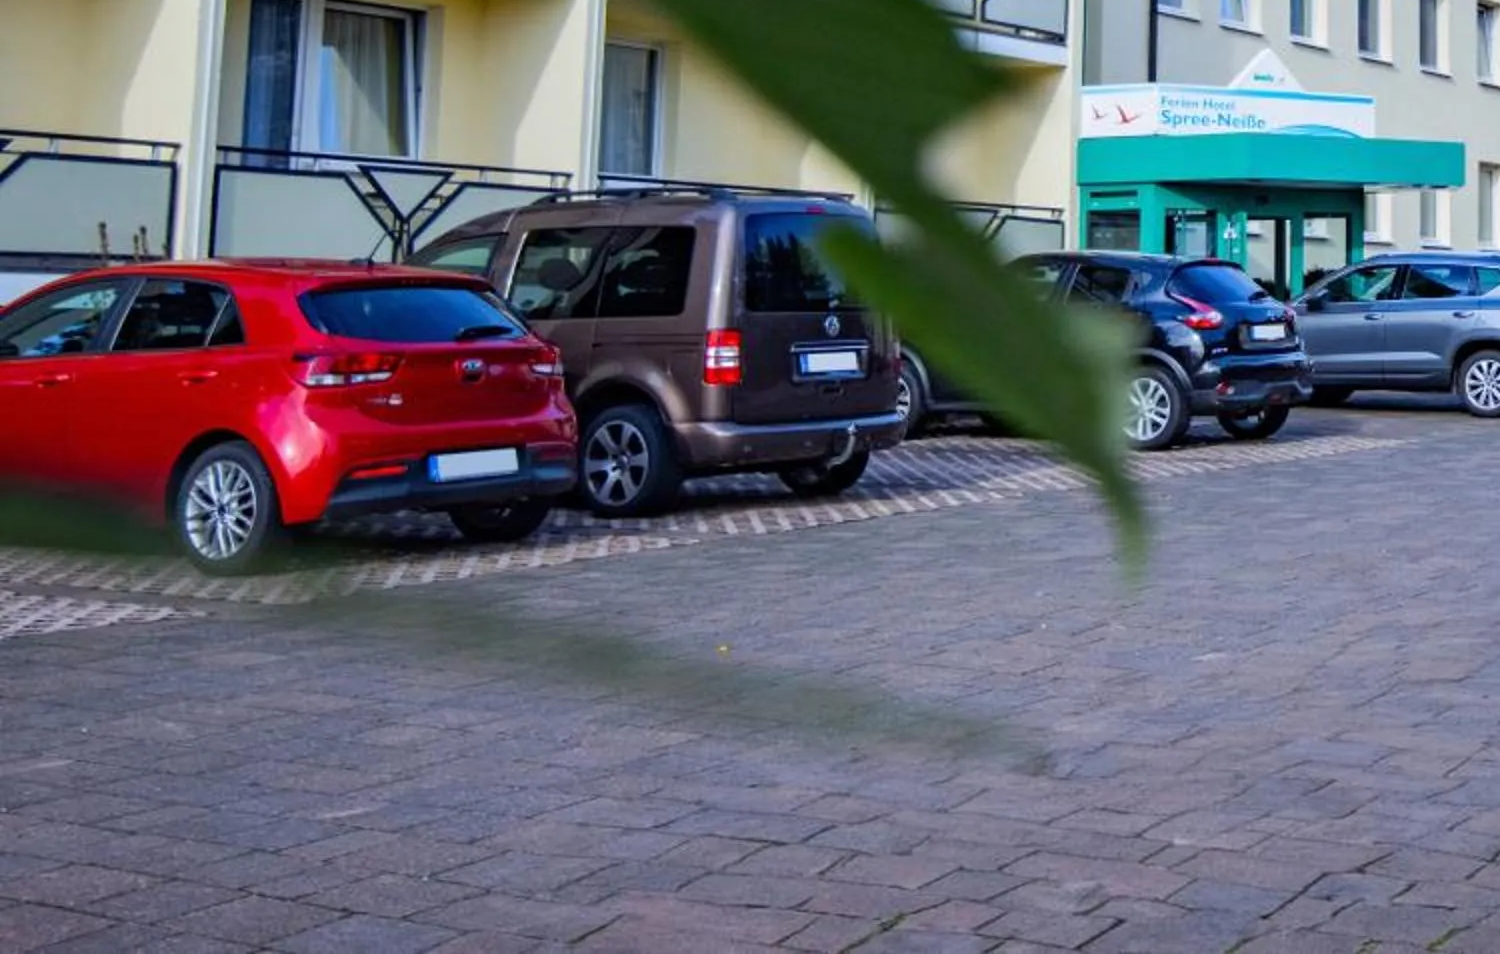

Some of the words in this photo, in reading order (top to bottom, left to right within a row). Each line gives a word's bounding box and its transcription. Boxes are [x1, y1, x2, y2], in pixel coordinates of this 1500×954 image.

[1160, 95, 1199, 108] Ferien
[1203, 98, 1235, 110] Hotel
[1160, 109, 1266, 128] Spree-Neiße
